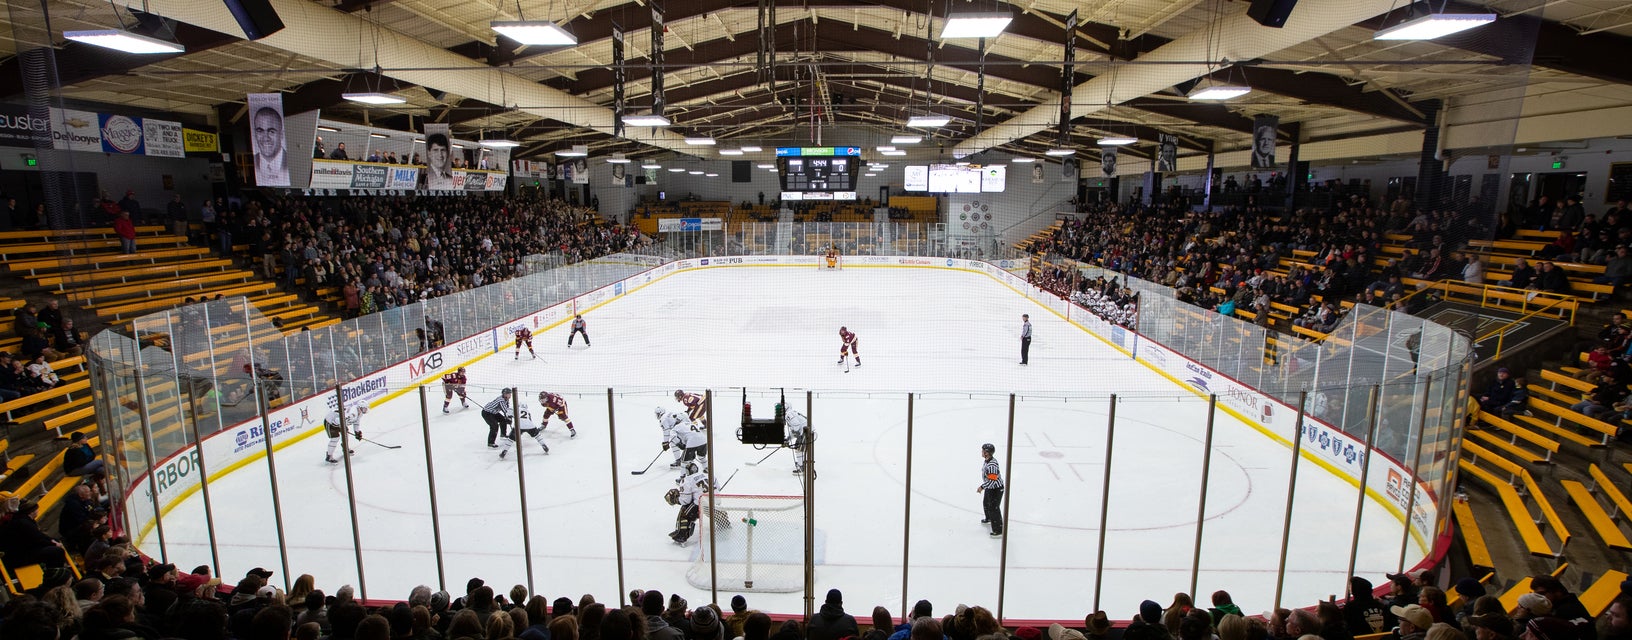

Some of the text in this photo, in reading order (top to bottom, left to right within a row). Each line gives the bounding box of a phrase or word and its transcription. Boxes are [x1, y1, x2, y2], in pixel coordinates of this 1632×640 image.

[0, 114, 50, 131] custer
[53, 131, 100, 145] DeNooyer
[187, 132, 214, 144] DICKEY'S
[354, 173, 384, 184] Michigan
[356, 165, 385, 175] Southern
[395, 169, 416, 182] MILK
[452, 171, 466, 189] ijer
[493, 177, 506, 186] PNC
[302, 188, 468, 197] THE LAWSON LUNATICS
[457, 336, 483, 356] SEELYE
[409, 352, 443, 380] MKB
[342, 376, 387, 402] BlackBerry
[1227, 385, 1258, 410] HONOR
[249, 420, 283, 439] Rige
[146, 450, 200, 498] RBOR
